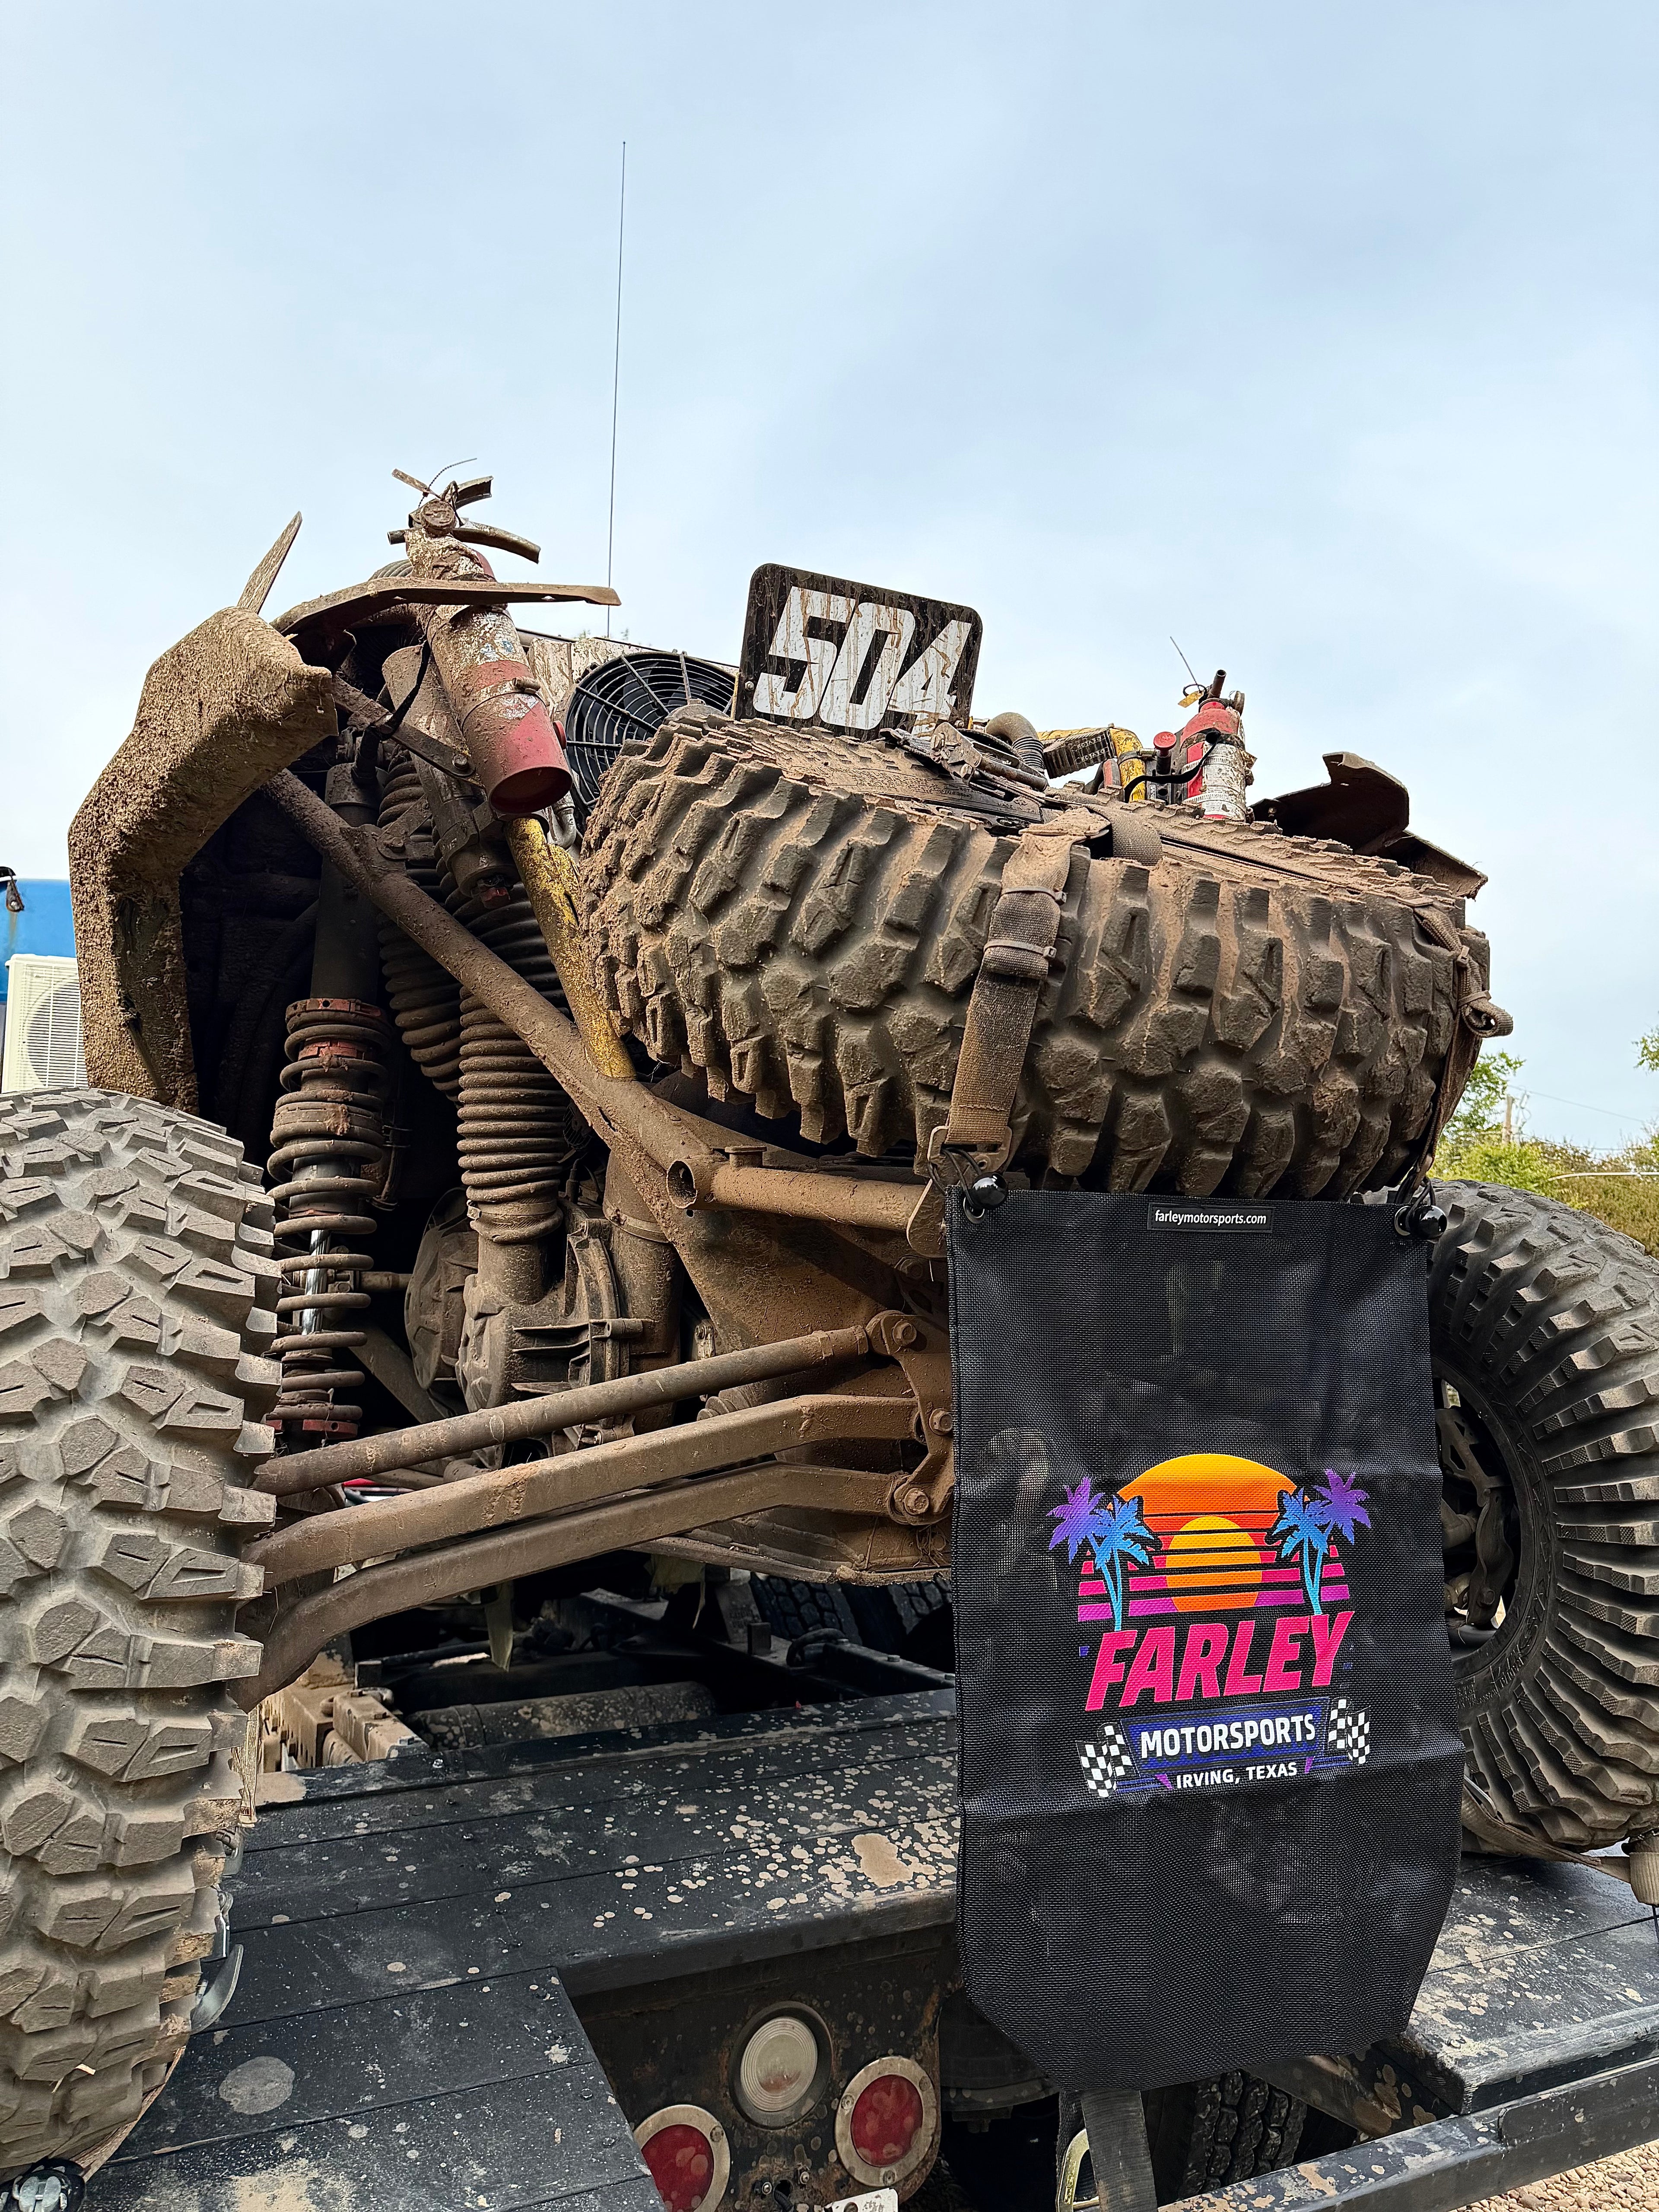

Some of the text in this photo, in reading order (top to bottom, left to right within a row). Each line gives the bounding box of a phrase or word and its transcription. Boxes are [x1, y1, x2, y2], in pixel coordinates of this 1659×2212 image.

[752, 585, 972, 735] 504
[1154, 1209, 1266, 1227] farleymotorsports.com
[1085, 1611, 1355, 1711] FARLEY
[1141, 1713, 1316, 1758] MOTORSPORTS
[1176, 1762, 1297, 1789] IRVING, TEXAS
